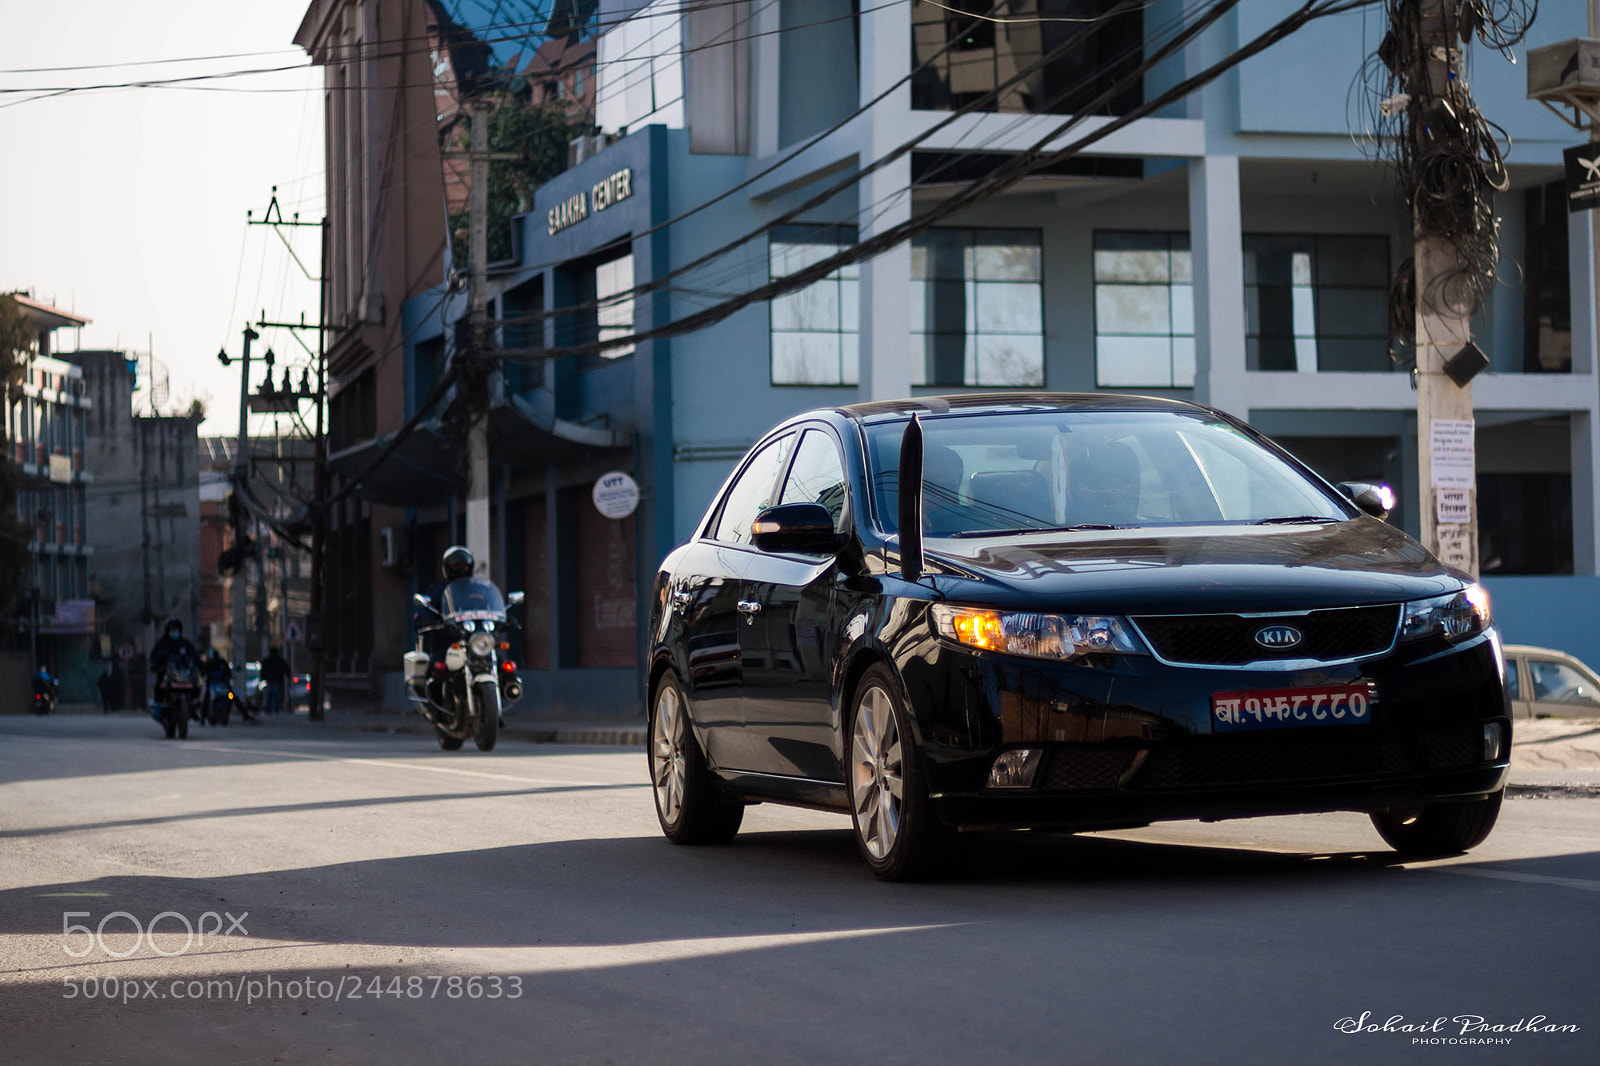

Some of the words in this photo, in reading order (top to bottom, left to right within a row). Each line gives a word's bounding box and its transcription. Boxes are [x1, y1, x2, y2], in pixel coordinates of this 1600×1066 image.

[548, 191, 587, 236] SAAKHA
[592, 168, 631, 212] CENTER
[1263, 630, 1296, 644] KIA
